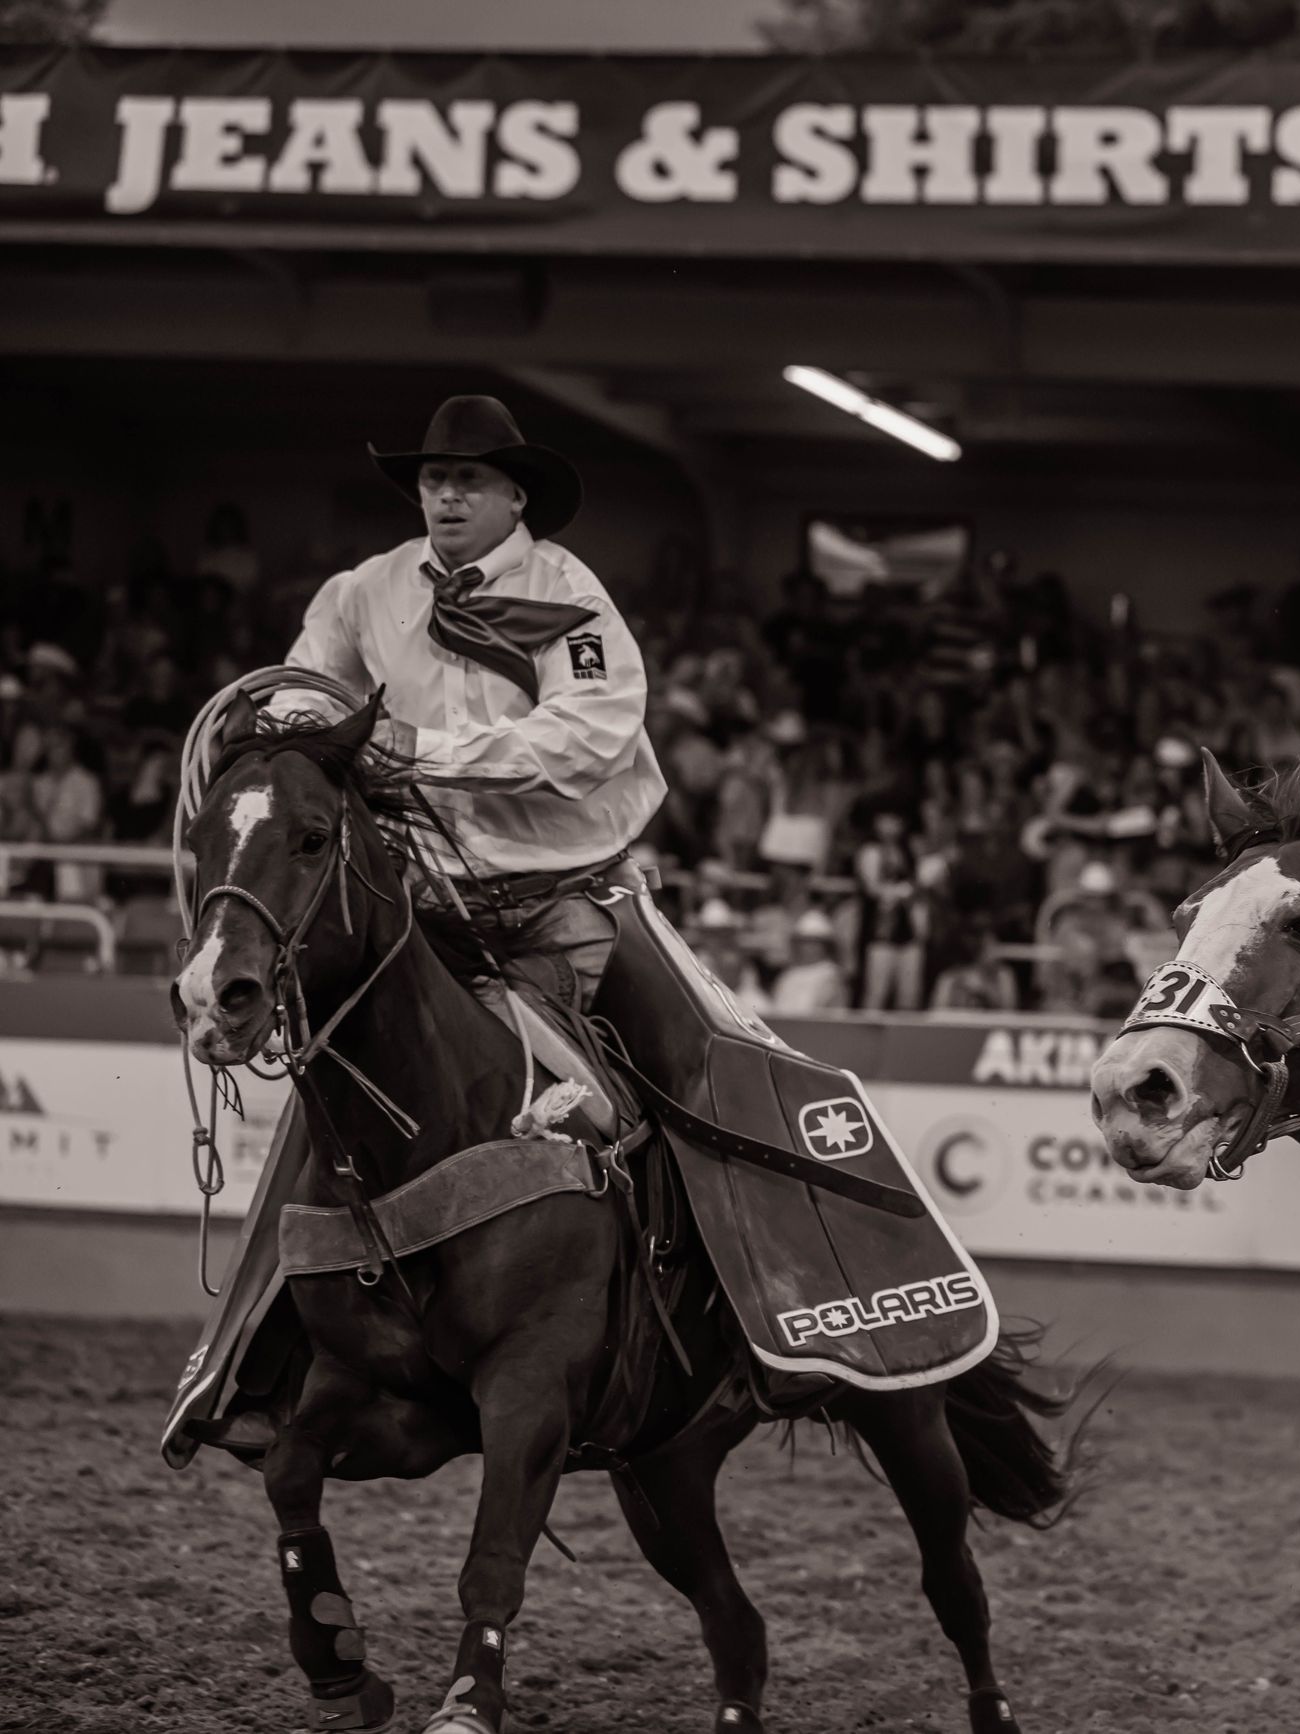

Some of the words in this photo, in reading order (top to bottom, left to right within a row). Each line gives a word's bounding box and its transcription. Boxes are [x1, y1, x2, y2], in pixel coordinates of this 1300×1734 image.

[105, 95, 581, 214] JEANS
[615, 101, 739, 204] &
[780, 1274, 982, 1344] POLARIS
